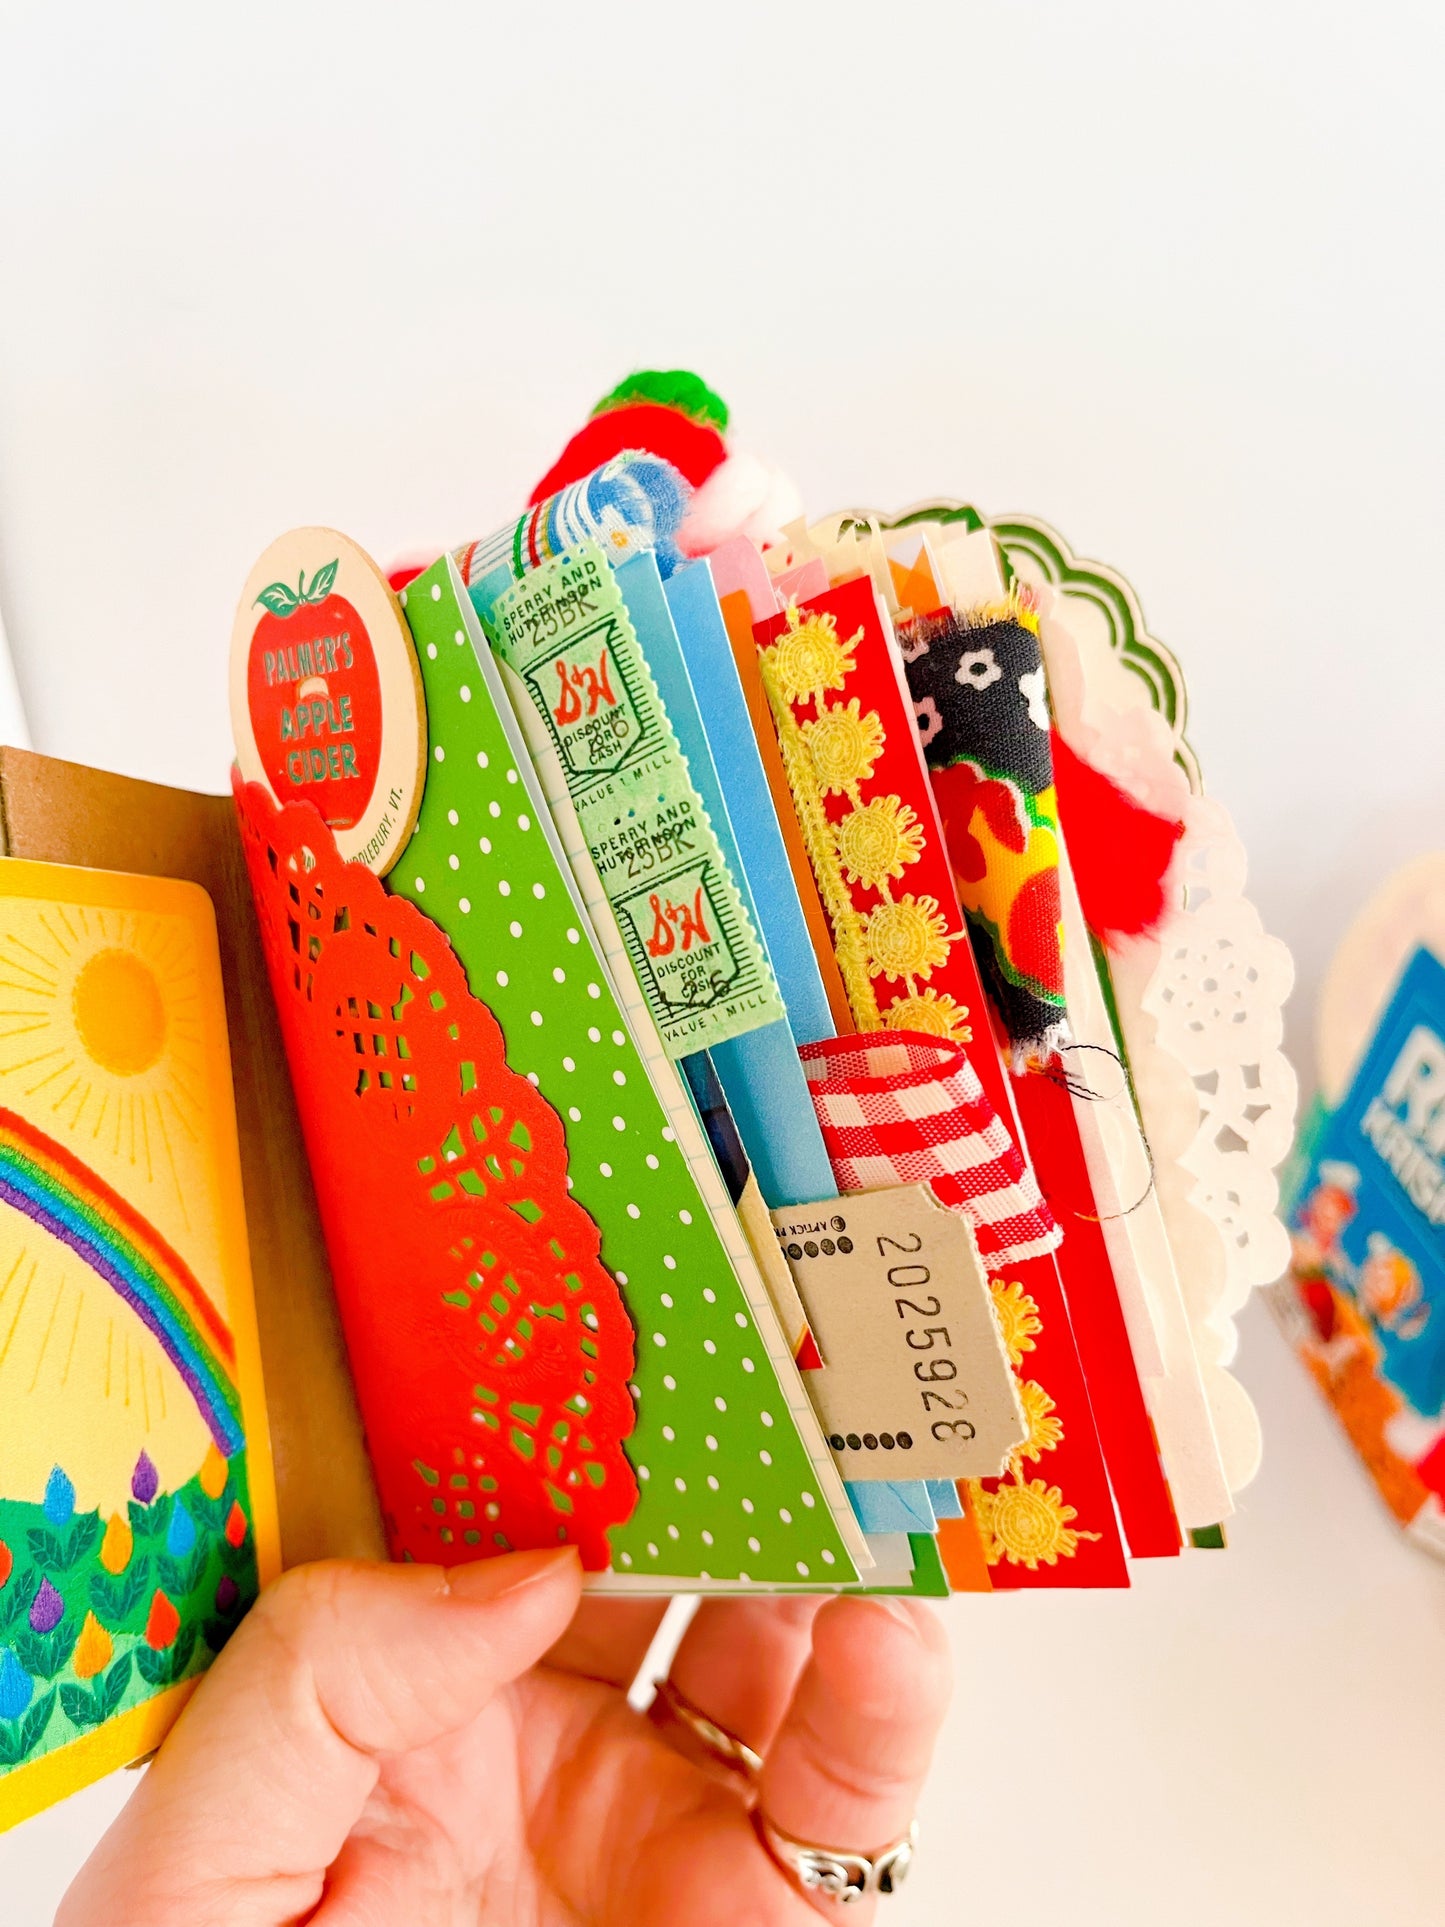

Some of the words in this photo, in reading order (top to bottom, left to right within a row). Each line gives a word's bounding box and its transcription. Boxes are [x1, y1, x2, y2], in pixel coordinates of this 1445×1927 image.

[503, 586, 552, 632] SPERRY
[561, 560, 597, 589] AND
[264, 632, 353, 686] PALMER'S
[281, 696, 355, 742] APPLE
[563, 703, 626, 748] DISCOUNT
[588, 729, 613, 748] FOR
[287, 742, 360, 785] CIDER
[589, 739, 623, 766] CASH
[572, 783, 615, 813] VALUE
[633, 754, 672, 781] MILL
[591, 820, 647, 860] SPERRY
[656, 801, 691, 827] AND
[656, 942, 721, 979] DISCOUNT
[680, 965, 706, 984] FOR
[664, 1017, 706, 1043] VALUE
[726, 994, 767, 1019] MILL
[876, 1232, 976, 1442] 2025928
